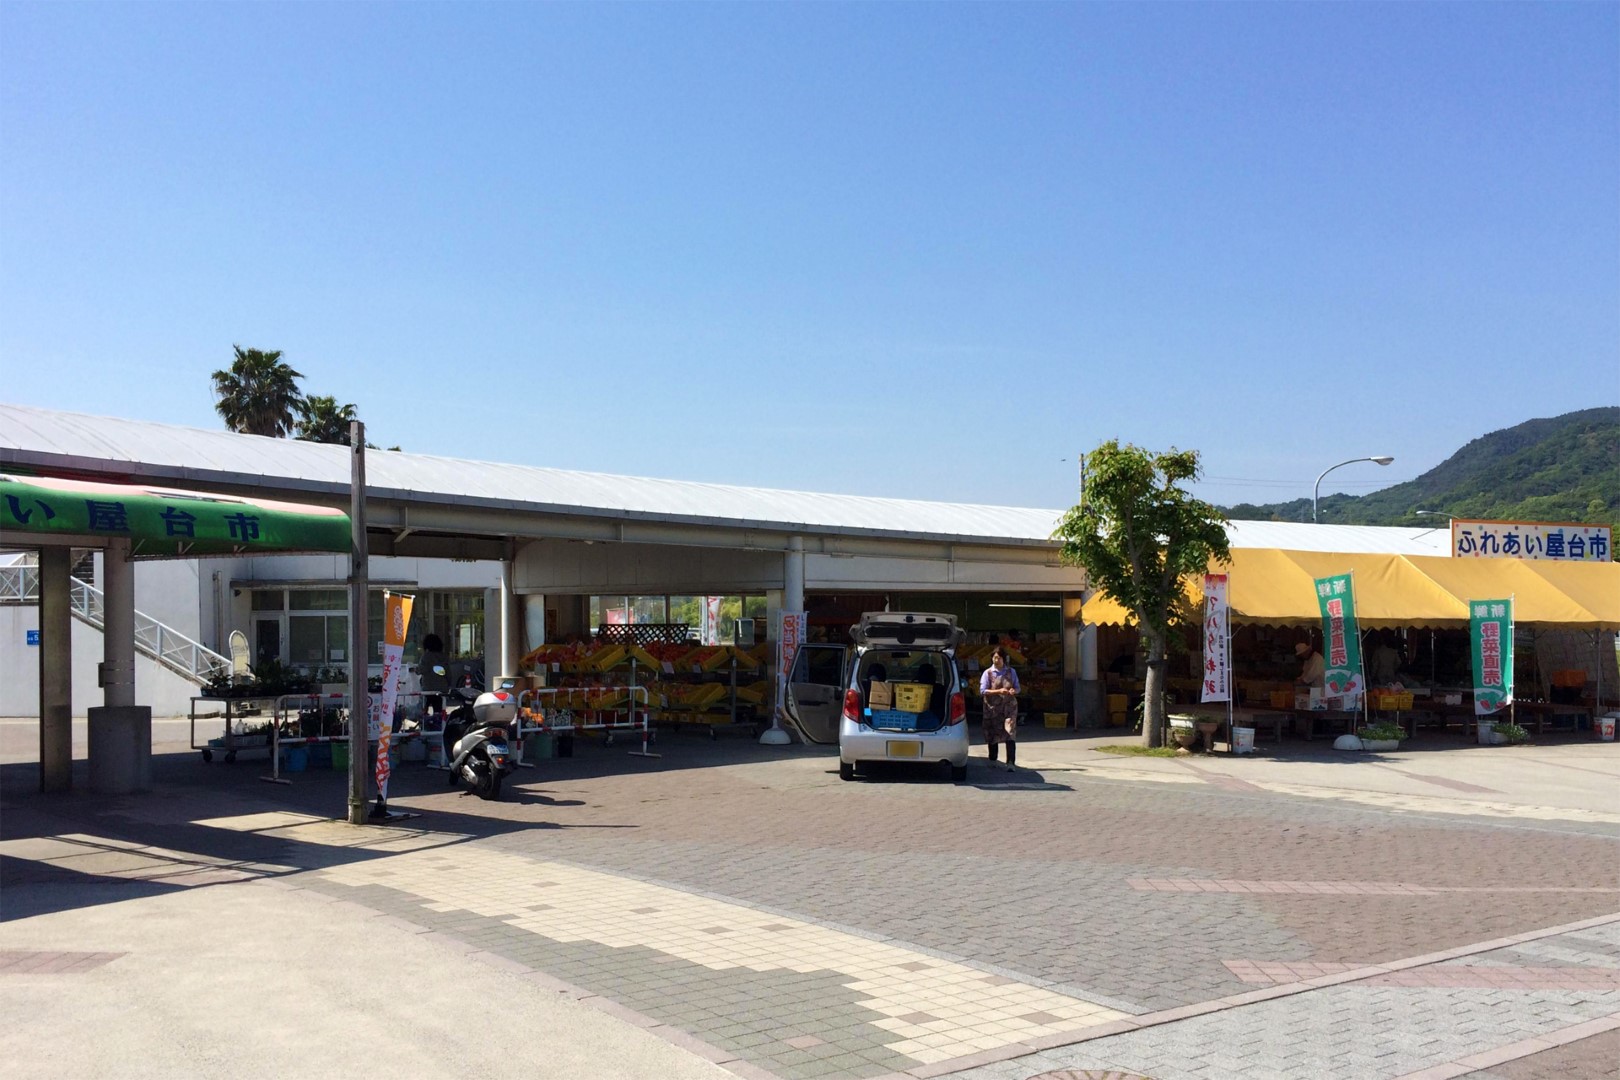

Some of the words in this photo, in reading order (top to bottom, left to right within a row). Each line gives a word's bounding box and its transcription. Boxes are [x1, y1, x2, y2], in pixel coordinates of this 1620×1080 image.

[5, 493, 261, 542] い屋台市
[1457, 530, 1608, 559] ふれあい屋台市
